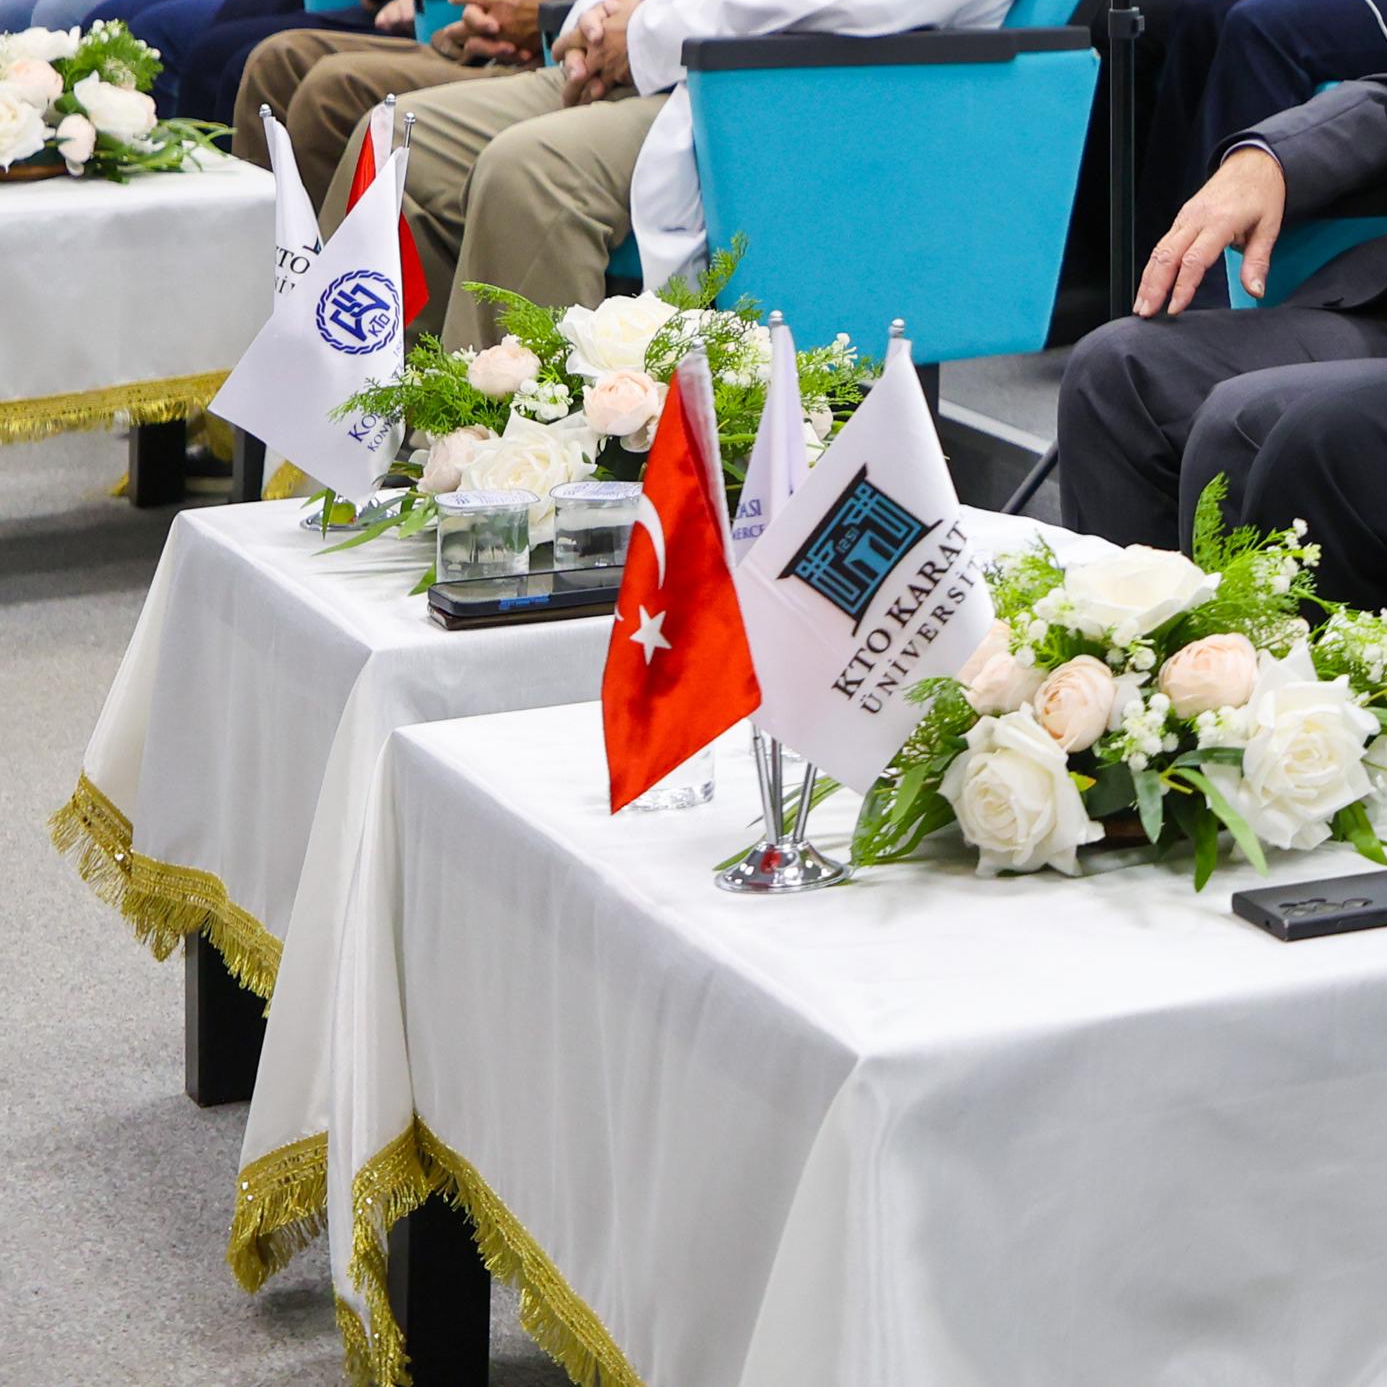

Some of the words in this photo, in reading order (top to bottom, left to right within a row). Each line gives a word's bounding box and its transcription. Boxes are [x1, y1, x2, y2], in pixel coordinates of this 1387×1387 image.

[275, 245, 311, 274] TO
[367, 313, 391, 337] KTO
[832, 627, 892, 701] KTO
